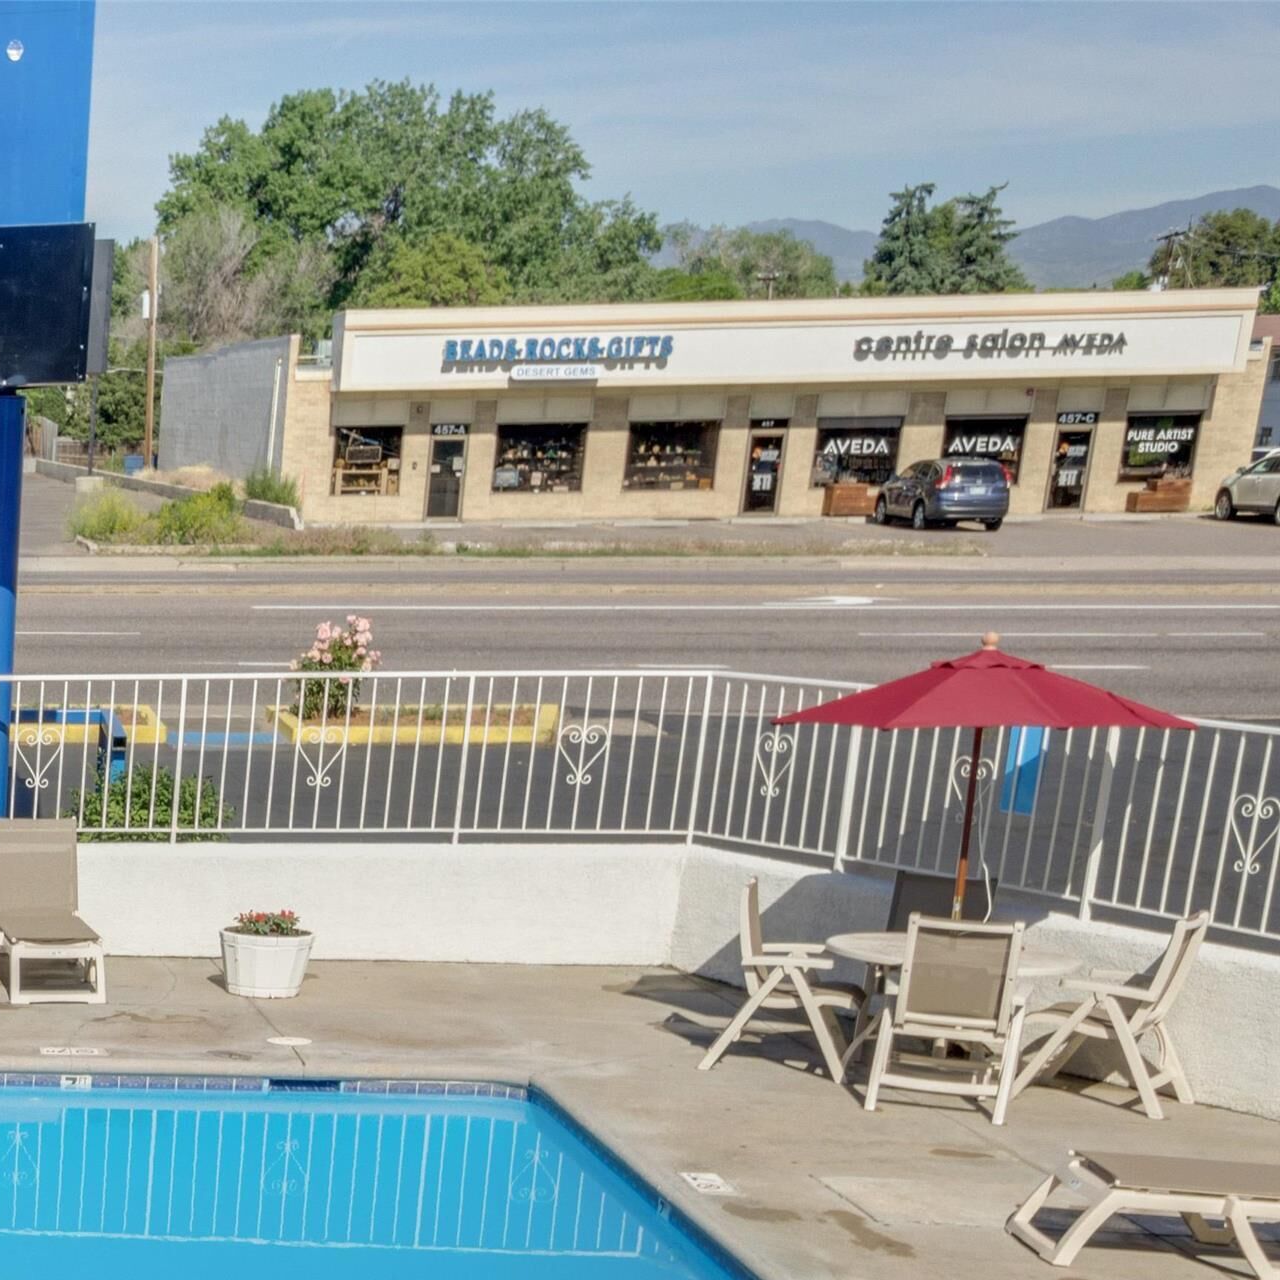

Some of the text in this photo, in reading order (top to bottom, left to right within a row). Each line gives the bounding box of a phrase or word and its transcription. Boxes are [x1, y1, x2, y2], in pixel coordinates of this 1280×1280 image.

[964, 328, 1046, 354] salon
[516, 366, 596, 378] DESERT GEMS
[1127, 428, 1194, 441] PURE ARTIST
[824, 438, 889, 455] AVEDA
[948, 436, 1015, 453] AVEDA
[1137, 442, 1179, 453] STUDIO
